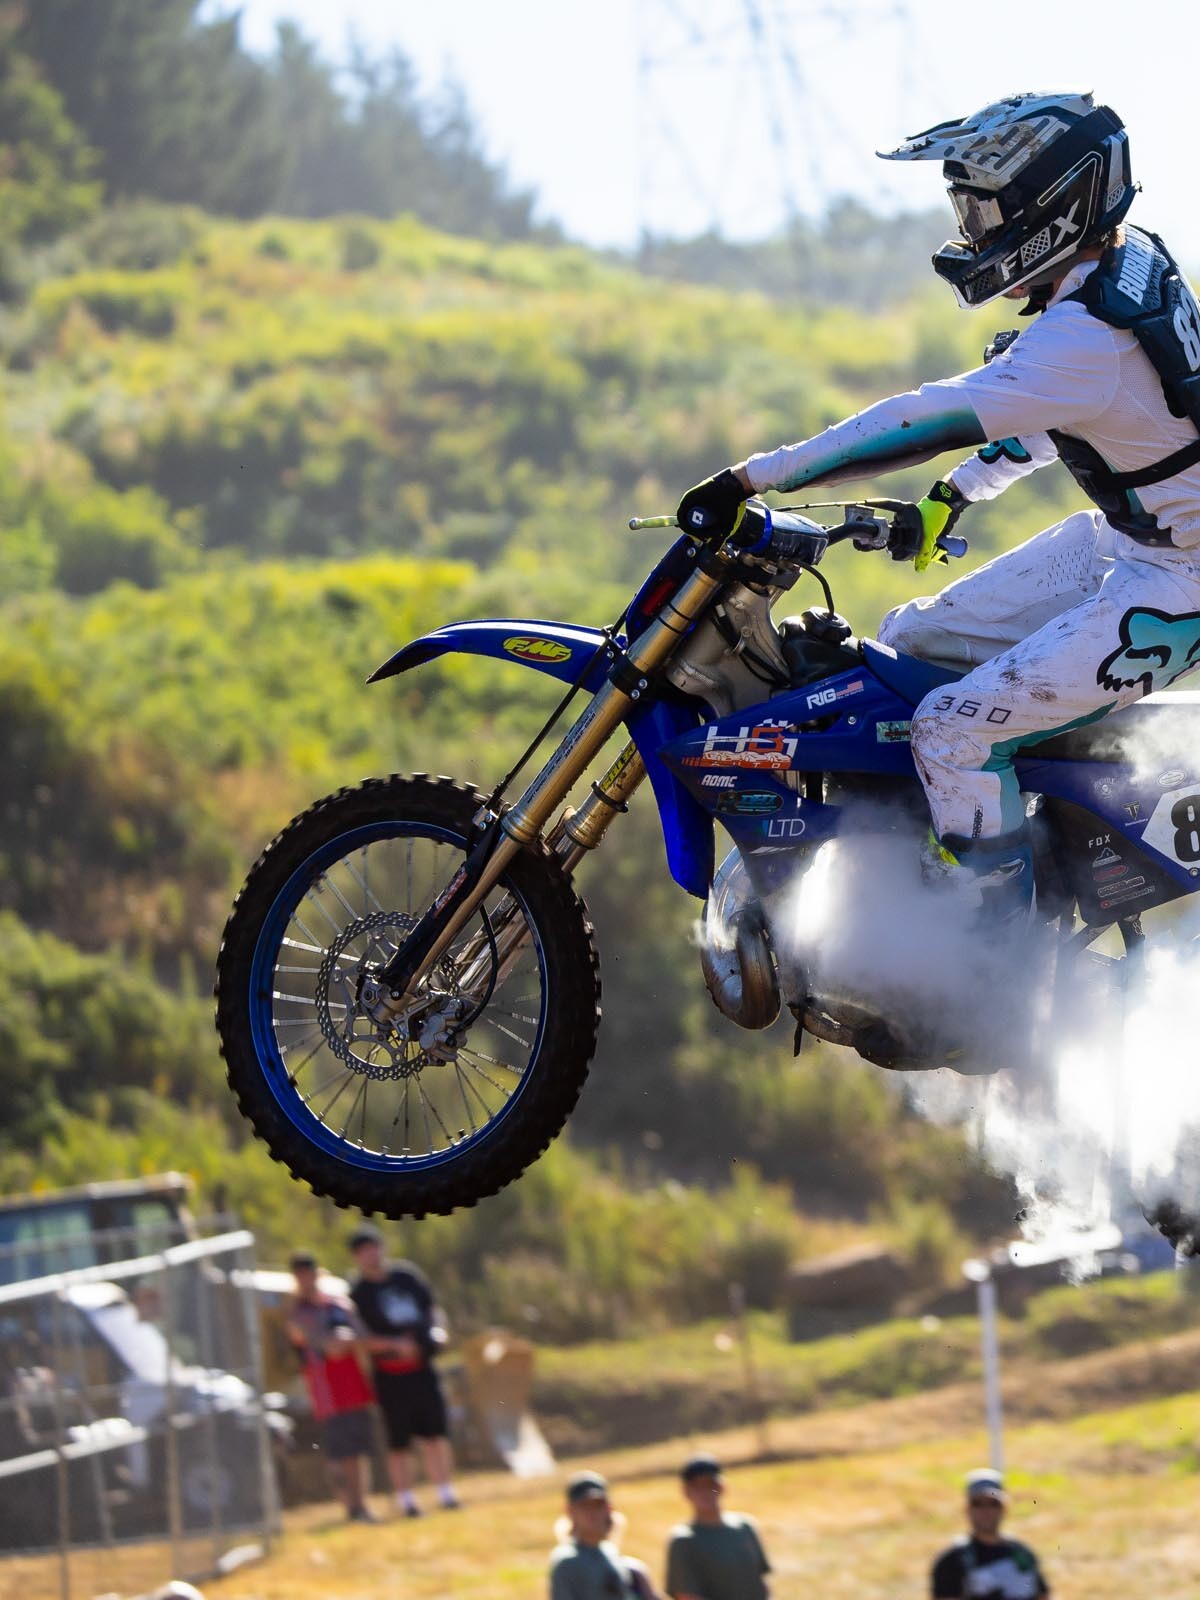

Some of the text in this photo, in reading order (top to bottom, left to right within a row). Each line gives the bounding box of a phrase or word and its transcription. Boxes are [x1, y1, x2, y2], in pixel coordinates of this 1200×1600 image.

[1000, 198, 1081, 281] FOX
[503, 638, 573, 658] FMF
[806, 687, 836, 710] RIG
[933, 696, 1013, 725] 360
[768, 818, 805, 838] LTD
[1088, 834, 1112, 849] FOX
